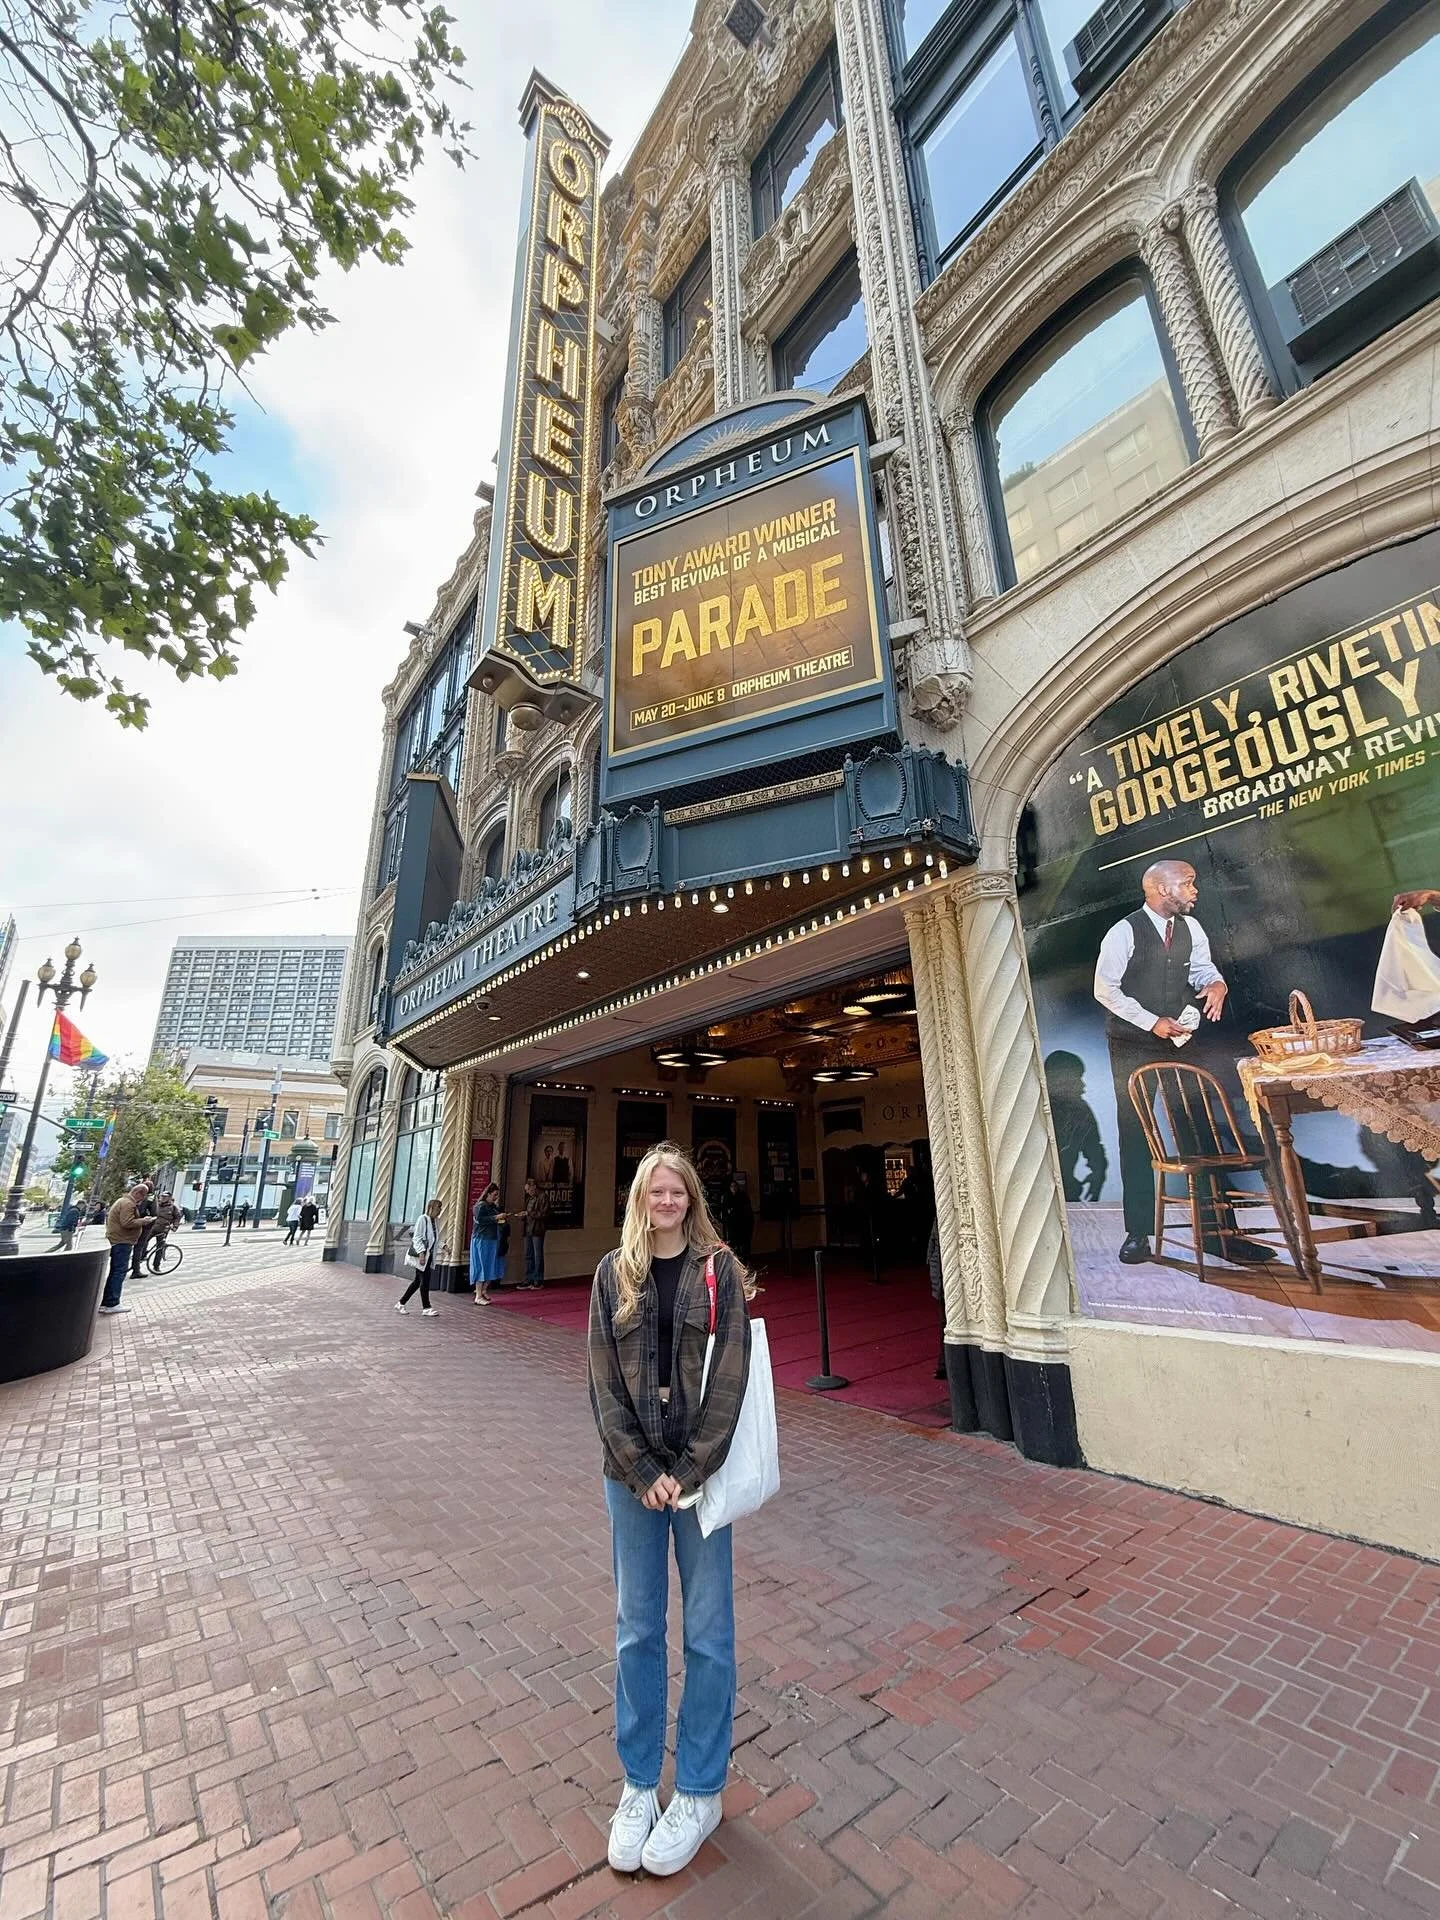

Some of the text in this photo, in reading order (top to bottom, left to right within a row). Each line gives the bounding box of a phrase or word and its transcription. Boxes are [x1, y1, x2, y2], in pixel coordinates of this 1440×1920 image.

[514, 139, 592, 650] ORPHEUM
[634, 424, 833, 519] ORPHEUM
[632, 498, 836, 590] TONY AWARD WINNER
[633, 520, 841, 606] BEST REVIVAL OF A MUSICAL
[632, 553, 848, 677] PARADE
[634, 707, 659, 726] MAY
[717, 688, 725, 702] 8
[732, 668, 791, 698] ORPHEUM
[794, 649, 851, 679] THEATRE
[1089, 658, 1420, 836] GORGEOUSLY
[1106, 689, 1262, 780] TIMELY,
[1203, 745, 1352, 819] BROADWAY
[1258, 750, 1426, 820] THE NEW YORK TIMES
[399, 892, 559, 1016] ORPHEUM THEATRE
